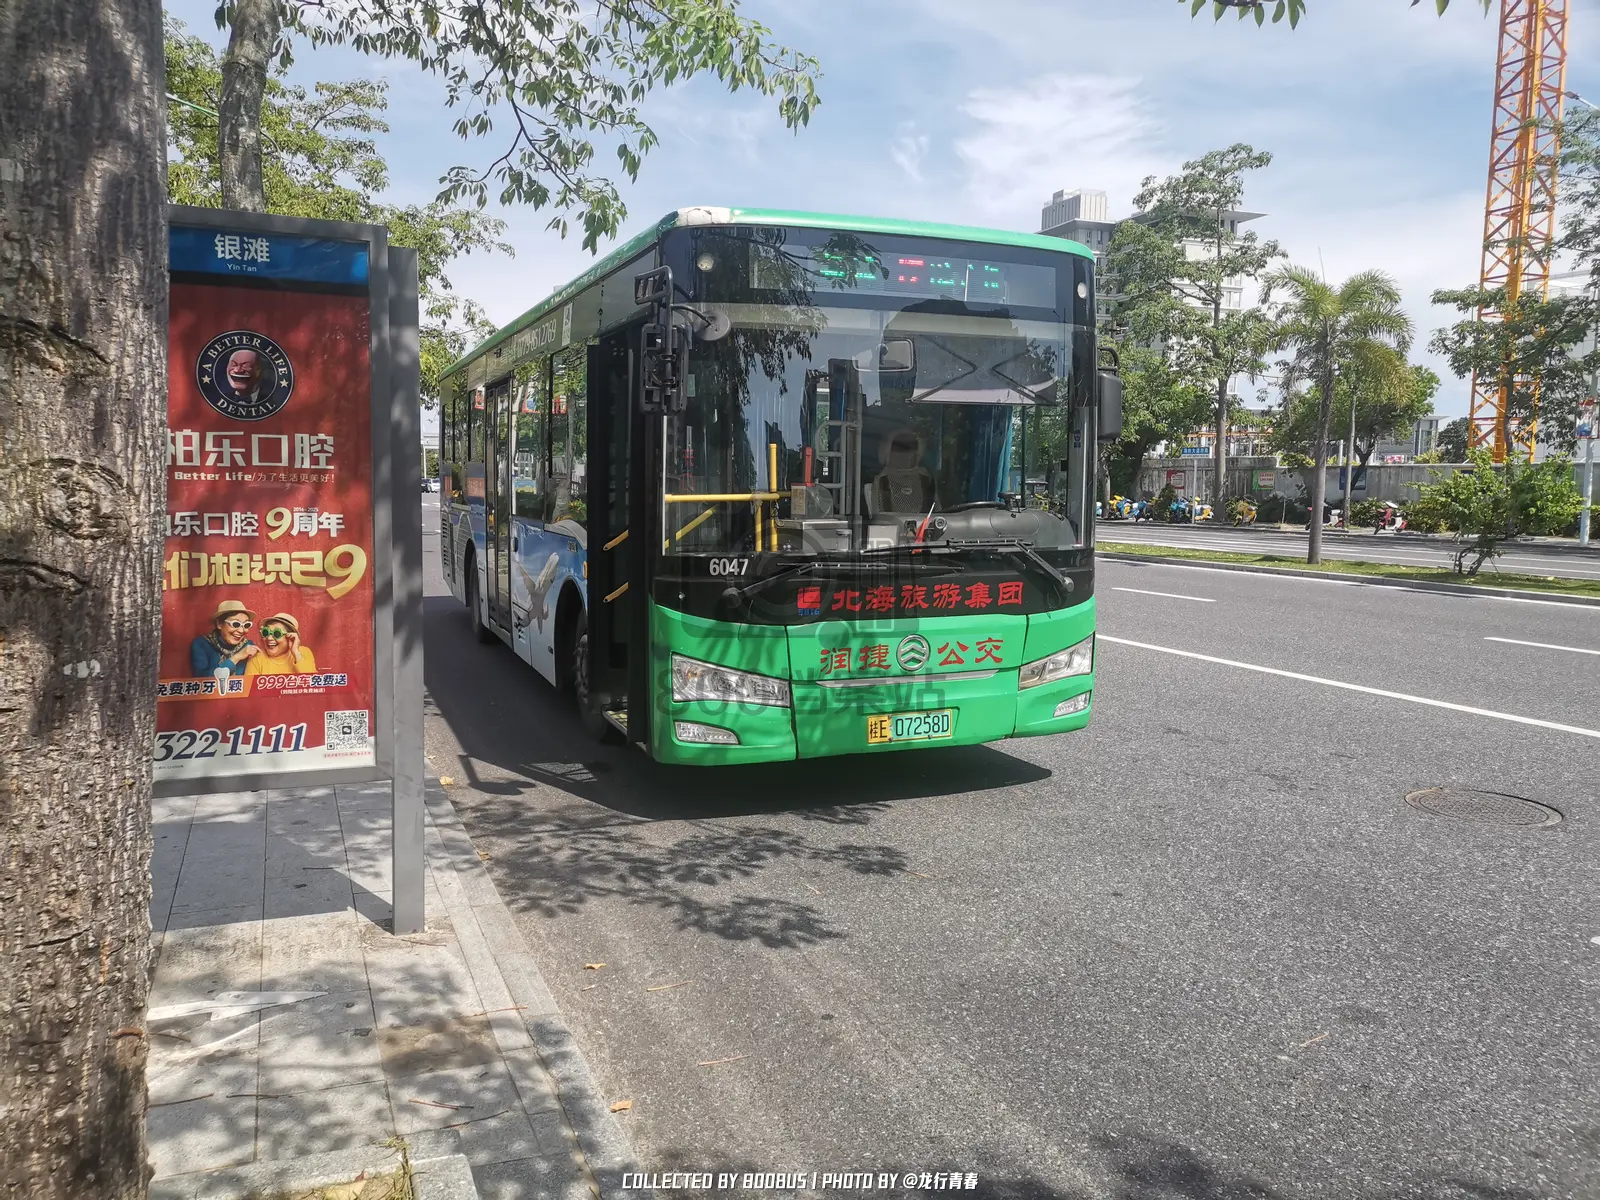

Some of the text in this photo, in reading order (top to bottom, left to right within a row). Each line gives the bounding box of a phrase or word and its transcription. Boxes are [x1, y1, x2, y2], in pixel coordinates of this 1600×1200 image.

[214, 233, 270, 263] 银滩
[227, 263, 257, 272] Yin Tan
[202, 335, 288, 376] A BETTER LIFE
[217, 398, 276, 417] DENTAL
[166, 429, 335, 469] 柏乐口腔
[174, 471, 221, 481] Better
[166, 511, 259, 537] 乐口腔
[162, 544, 367, 600] 们相识已9
[708, 558, 749, 577] 6047
[831, 581, 1025, 612] 北海旅游集团
[819, 637, 1005, 675] 润捷 公交
[256, 673, 348, 690] 999台车免费送
